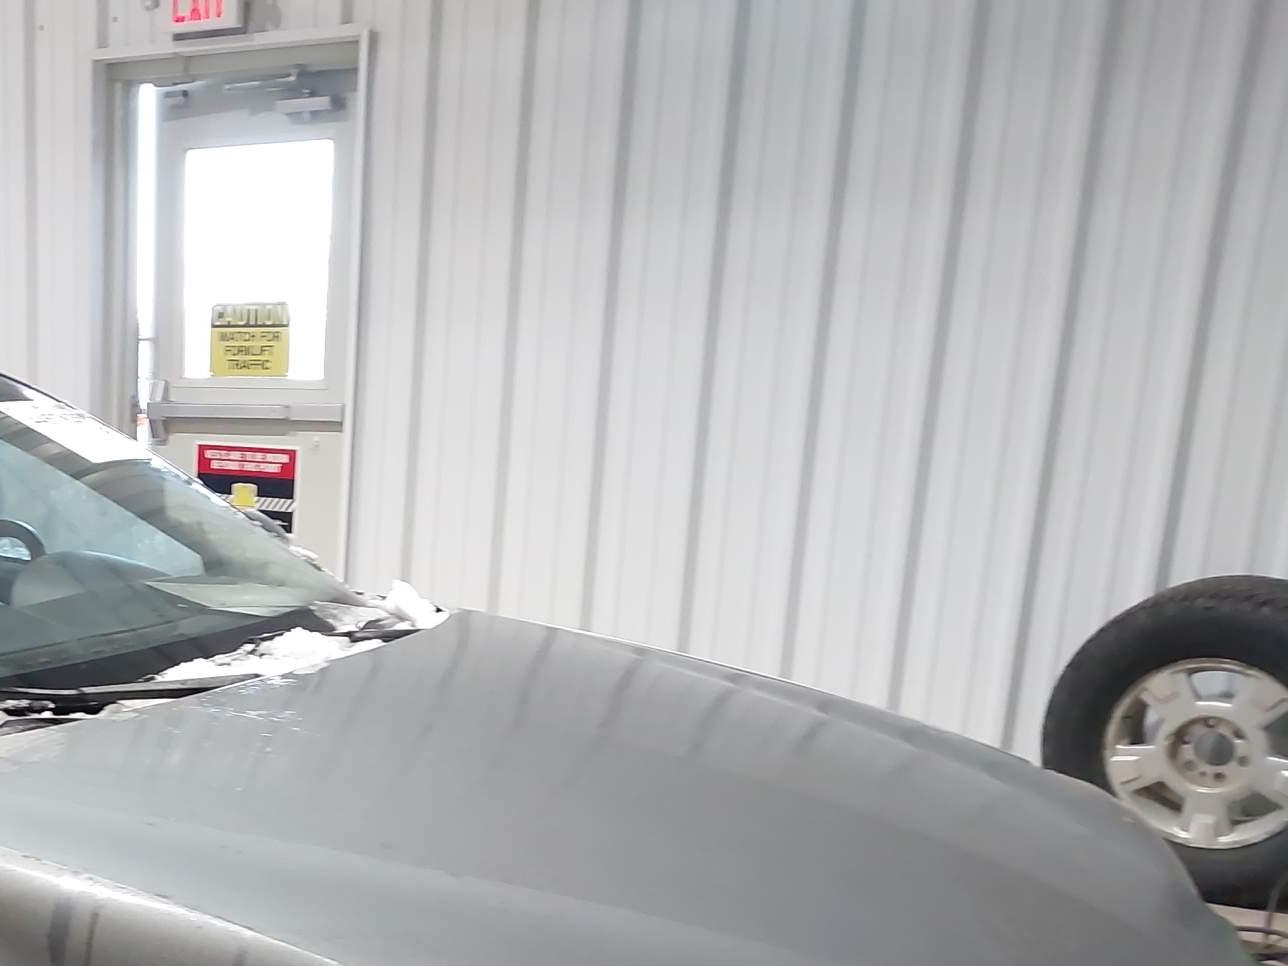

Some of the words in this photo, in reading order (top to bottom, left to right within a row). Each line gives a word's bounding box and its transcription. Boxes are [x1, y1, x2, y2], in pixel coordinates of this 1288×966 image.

[213, 304, 287, 326] CAUTION
[219, 331, 257, 342] WATCH
[260, 331, 281, 342] FOR
[224, 345, 275, 356] FORKLIFT
[226, 359, 272, 370] TRAFFIC
